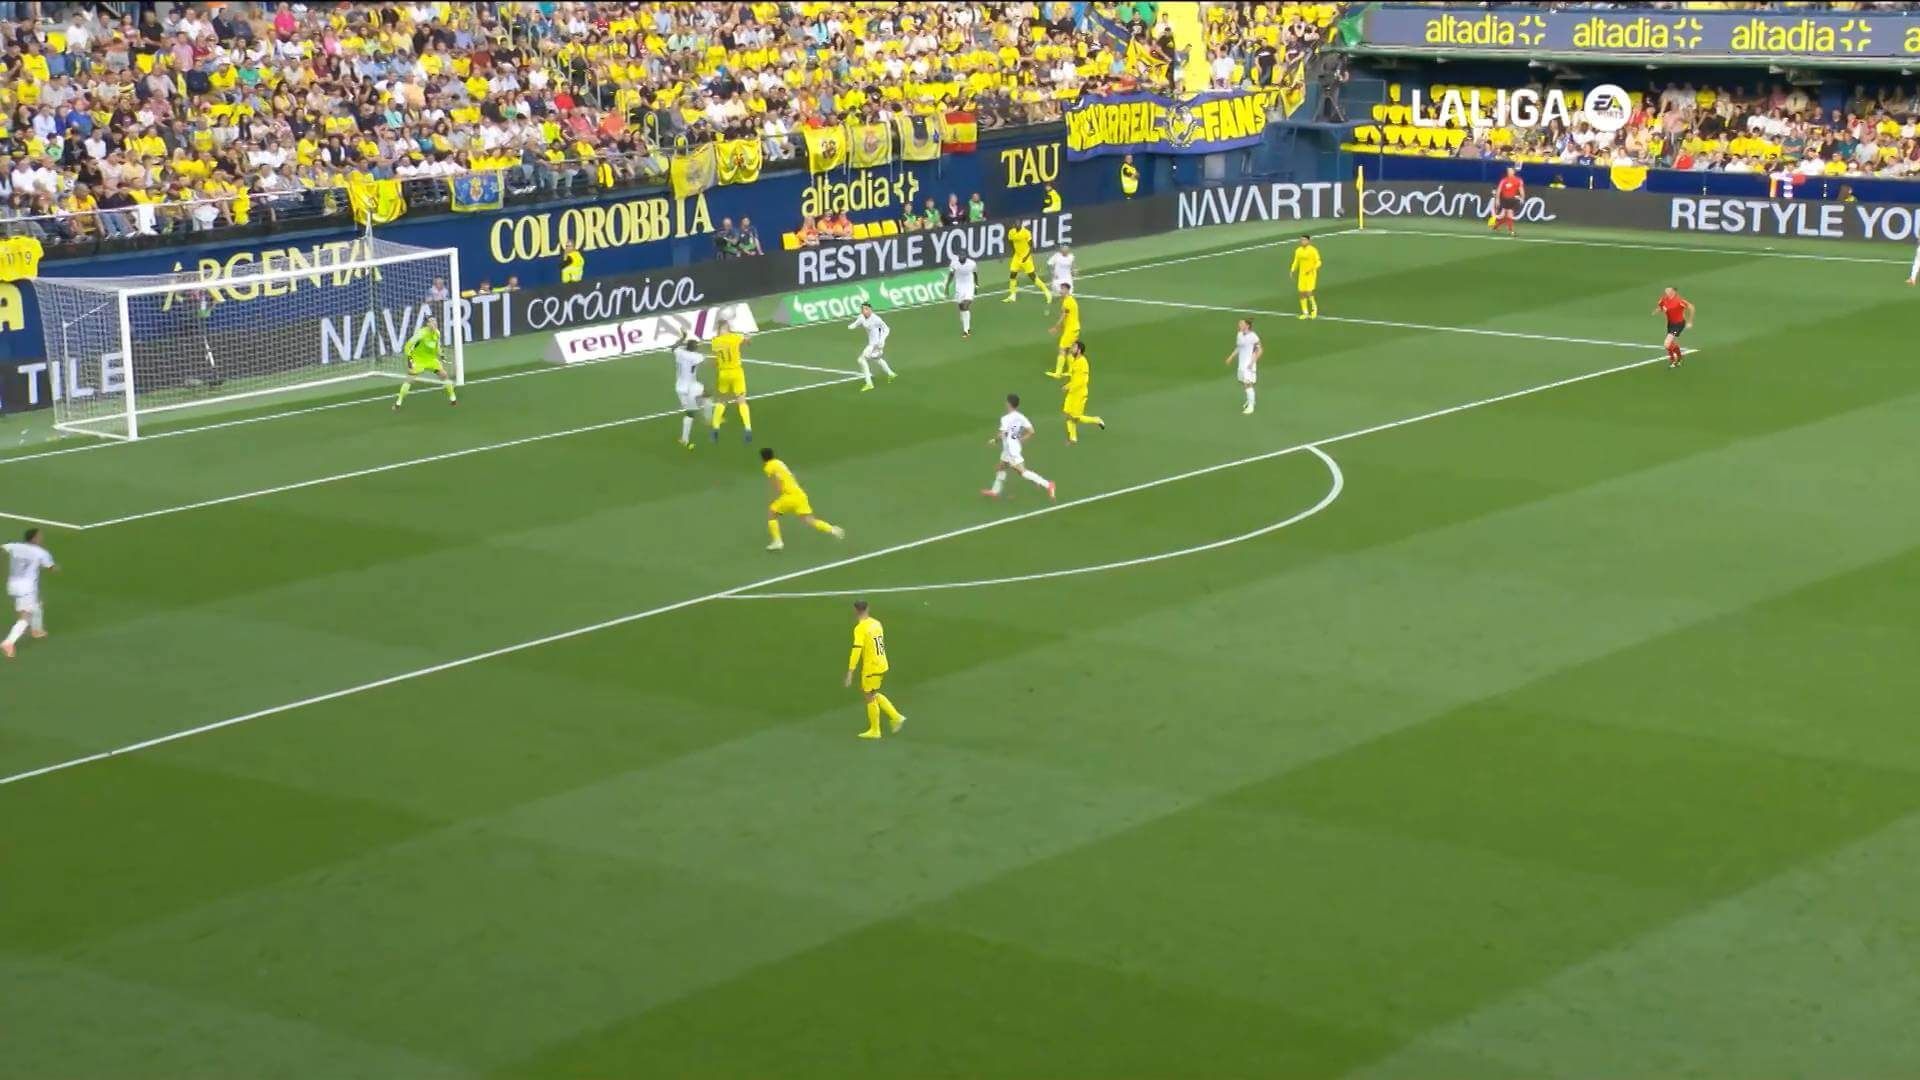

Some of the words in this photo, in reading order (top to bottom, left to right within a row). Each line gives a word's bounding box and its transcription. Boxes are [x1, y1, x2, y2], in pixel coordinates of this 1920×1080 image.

[1425, 13, 1515, 45] altadia
[1572, 17, 1669, 49] altadia
[1731, 18, 1835, 52] altadia
[1202, 93, 1266, 142] FANS
[1001, 143, 1061, 188] TAU
[801, 171, 890, 217] altadia
[1178, 182, 1342, 228] NAVARTI
[1362, 185, 1557, 222] cerámia
[490, 192, 714, 264] COLOROBBIA
[1671, 198, 1844, 238] RESTYLE
[1856, 206, 1920, 240] YO
[163, 239, 383, 312] ARGENTA
[799, 236, 924, 285] RESTYLE
[930, 223, 1005, 264] YOUR
[320, 292, 512, 365] NAVARTI
[526, 276, 704, 330] cerámica
[569, 322, 644, 356] renfe
[17, 352, 126, 404] TILE
